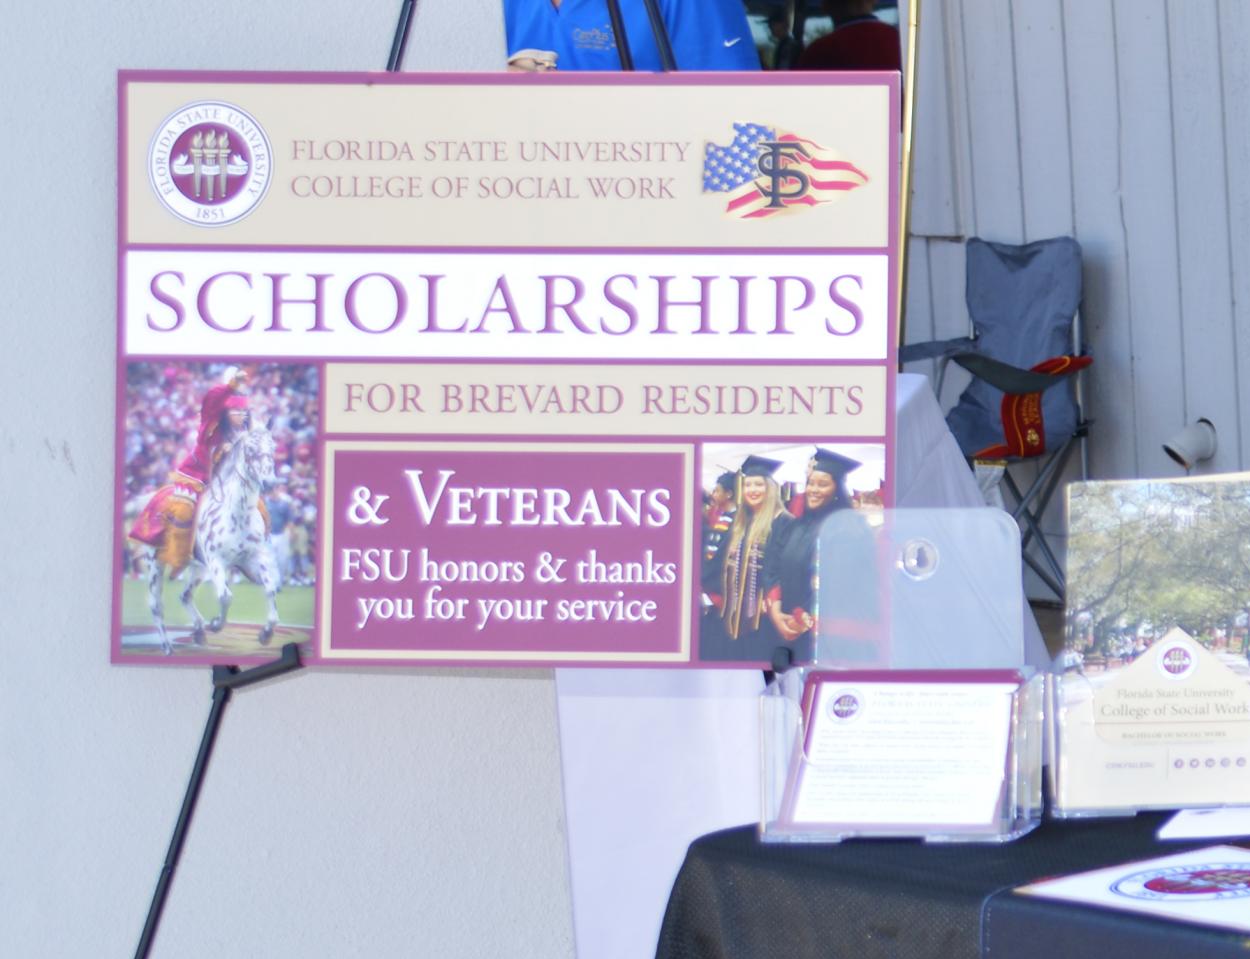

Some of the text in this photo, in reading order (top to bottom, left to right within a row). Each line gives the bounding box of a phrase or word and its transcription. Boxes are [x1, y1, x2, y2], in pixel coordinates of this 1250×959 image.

[156, 108, 266, 197] FLORIDA STATE UNIVERSITY
[291, 140, 691, 164] FLORIDA STATE UNIVERSITY
[291, 175, 676, 200] COLLEGE OF SOCIAL WORK
[195, 207, 226, 220] 1851
[146, 270, 865, 337] SCHOLARSHIPS
[343, 383, 864, 416] FOR BREVARD RESIDENTS
[347, 485, 390, 526] &
[340, 549, 677, 585] FSU honors & thanks
[356, 586, 658, 631] you for your service
[1117, 687, 1235, 699] Florida State University
[1100, 702, 1250, 720] College of Social Work
